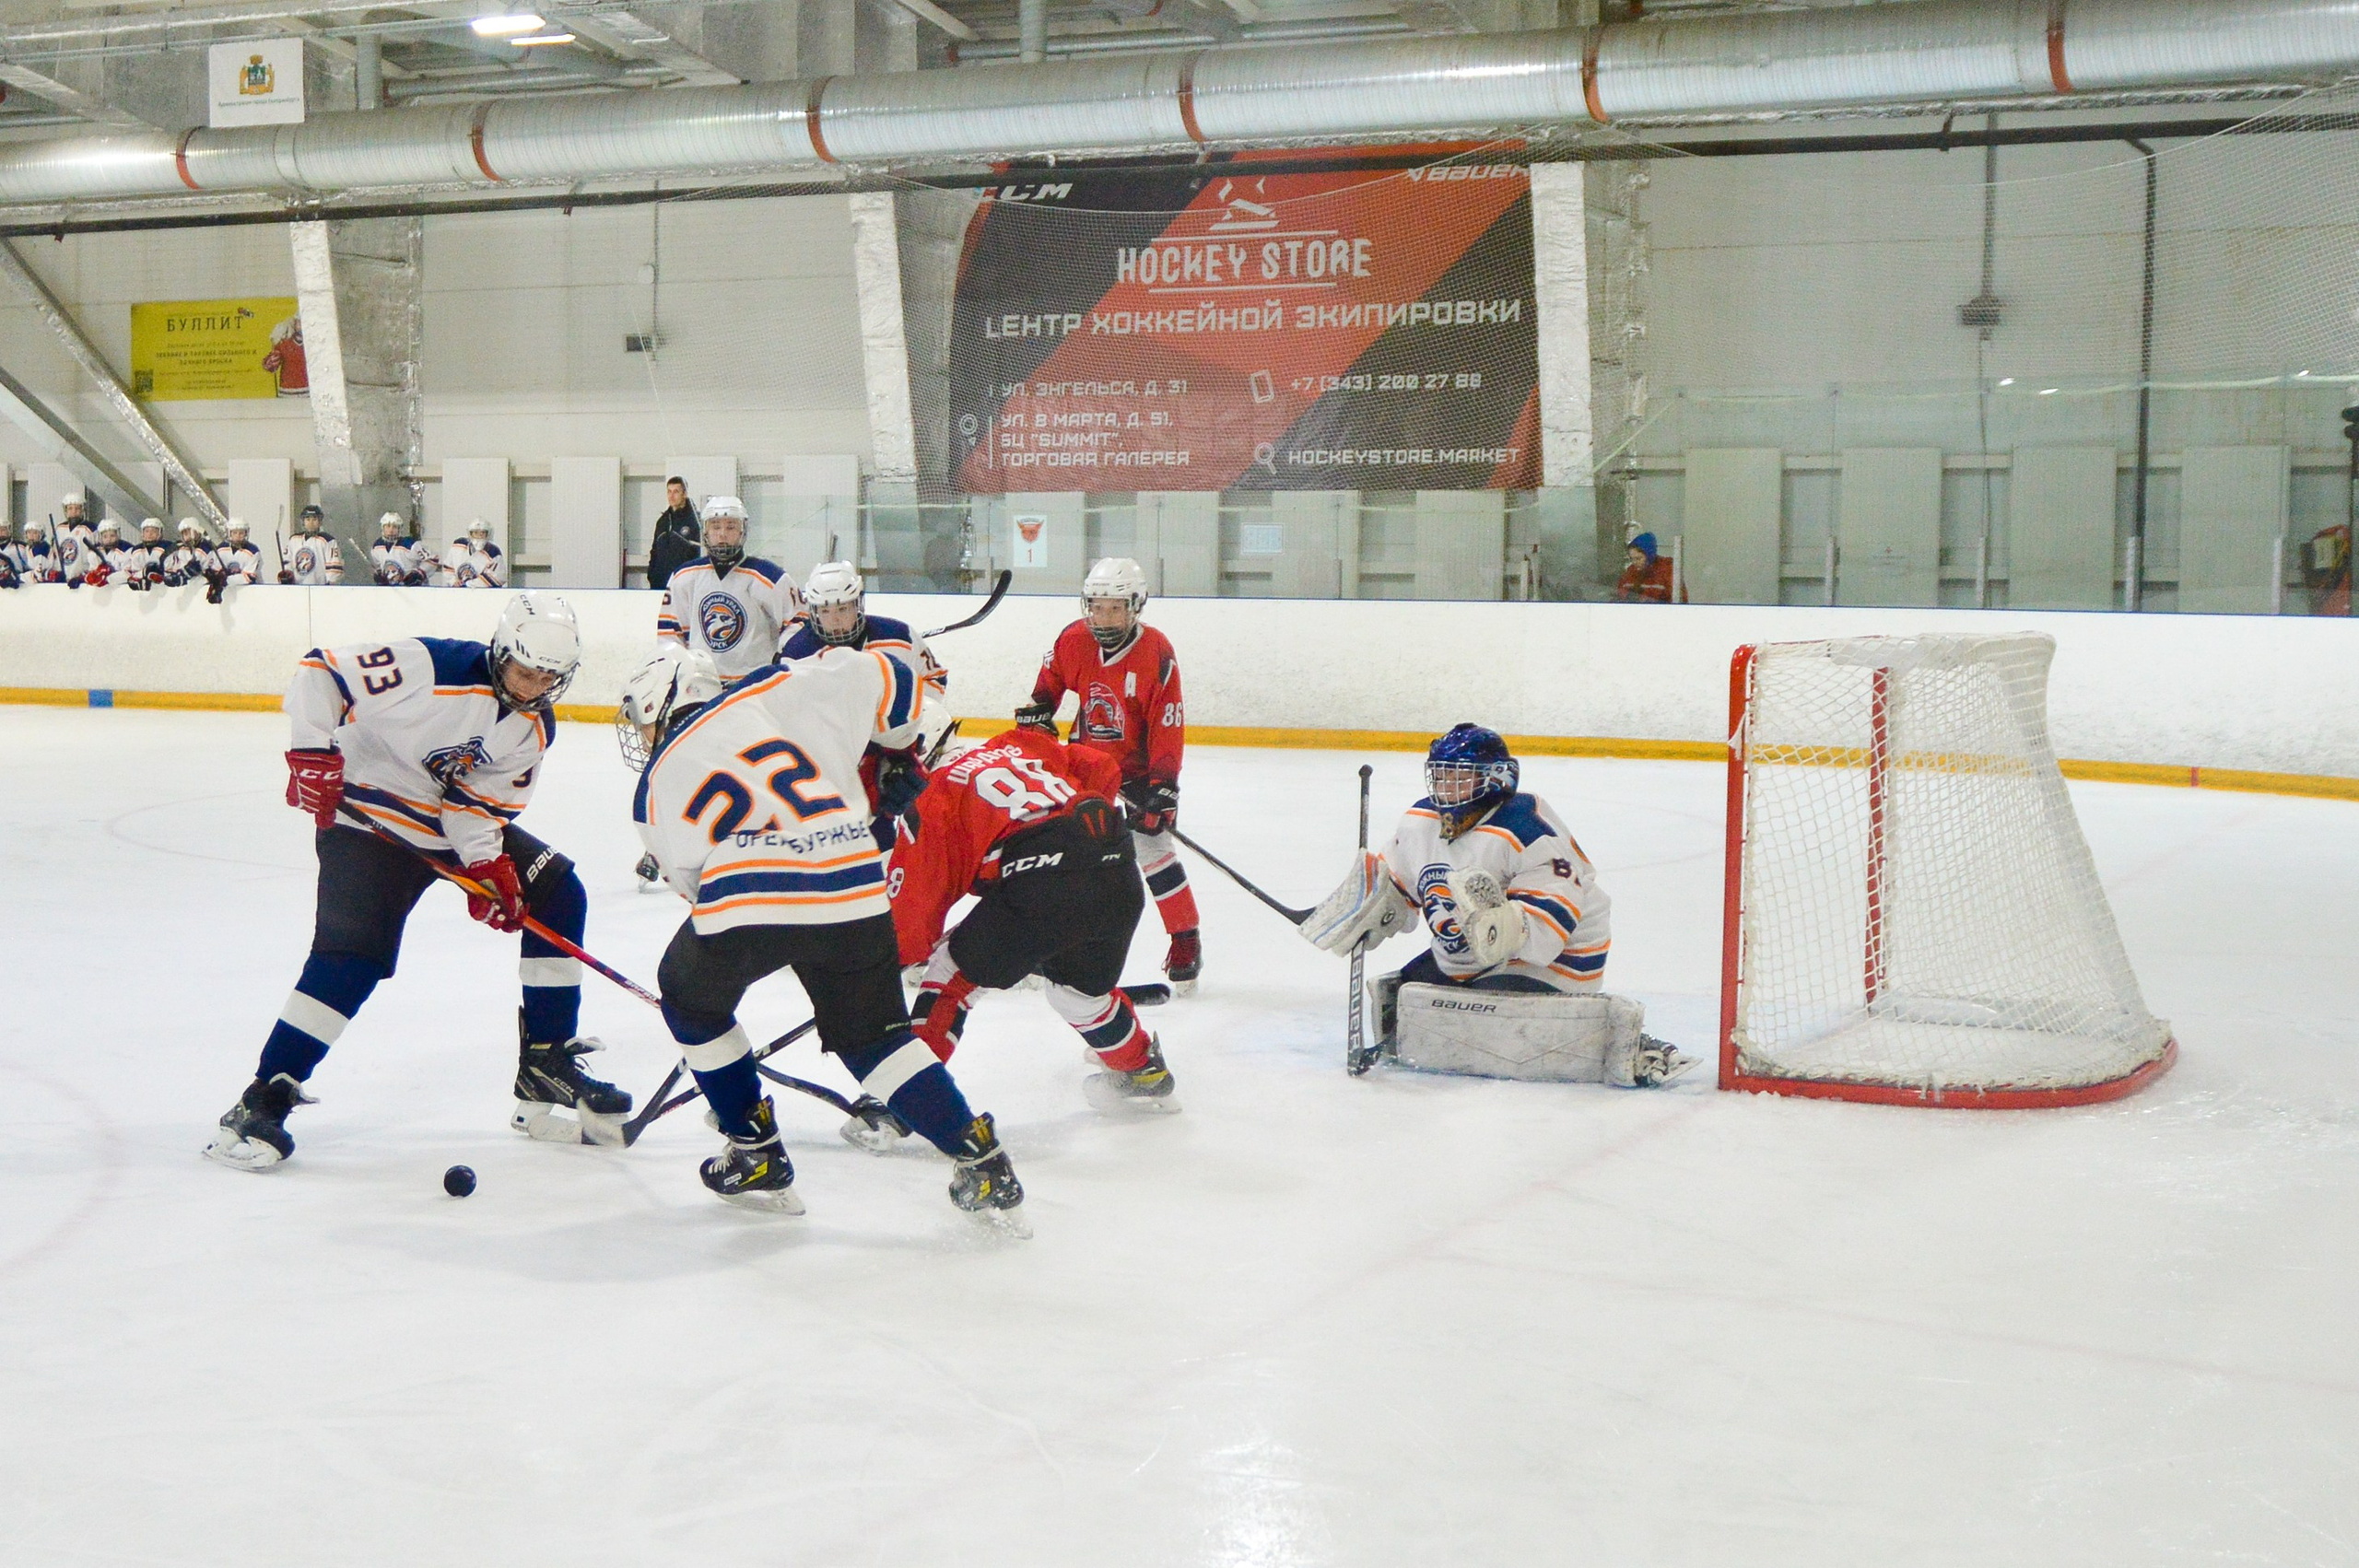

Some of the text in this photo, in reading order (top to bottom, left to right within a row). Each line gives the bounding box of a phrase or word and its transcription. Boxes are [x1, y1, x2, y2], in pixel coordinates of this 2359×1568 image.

[1118, 238, 1373, 284] HOCKEY STORE
[167, 315, 244, 333] БУЛЛИТ
[1091, 300, 1284, 334] ХОККЕЙНОЙ
[1296, 298, 1520, 328] ЭКИПИРОВКИ
[1168, 380, 1187, 394] 31
[1291, 377, 1312, 392] +7
[1379, 374, 1419, 390] 200
[1426, 373, 1449, 389] 27
[1035, 414, 1048, 427] 8
[1053, 412, 1121, 427] МАРТА,
[1002, 451, 1190, 467] ТОРГОВАЯ ГАЛЕРЕЯ
[1289, 448, 1520, 465] HOCKEYSTORE.MARKET
[356, 646, 404, 696] 93
[682, 736, 851, 846] 22
[526, 847, 557, 883] BAU
[1002, 852, 1063, 878] CCM
[1431, 998, 1496, 1013] BAUER
